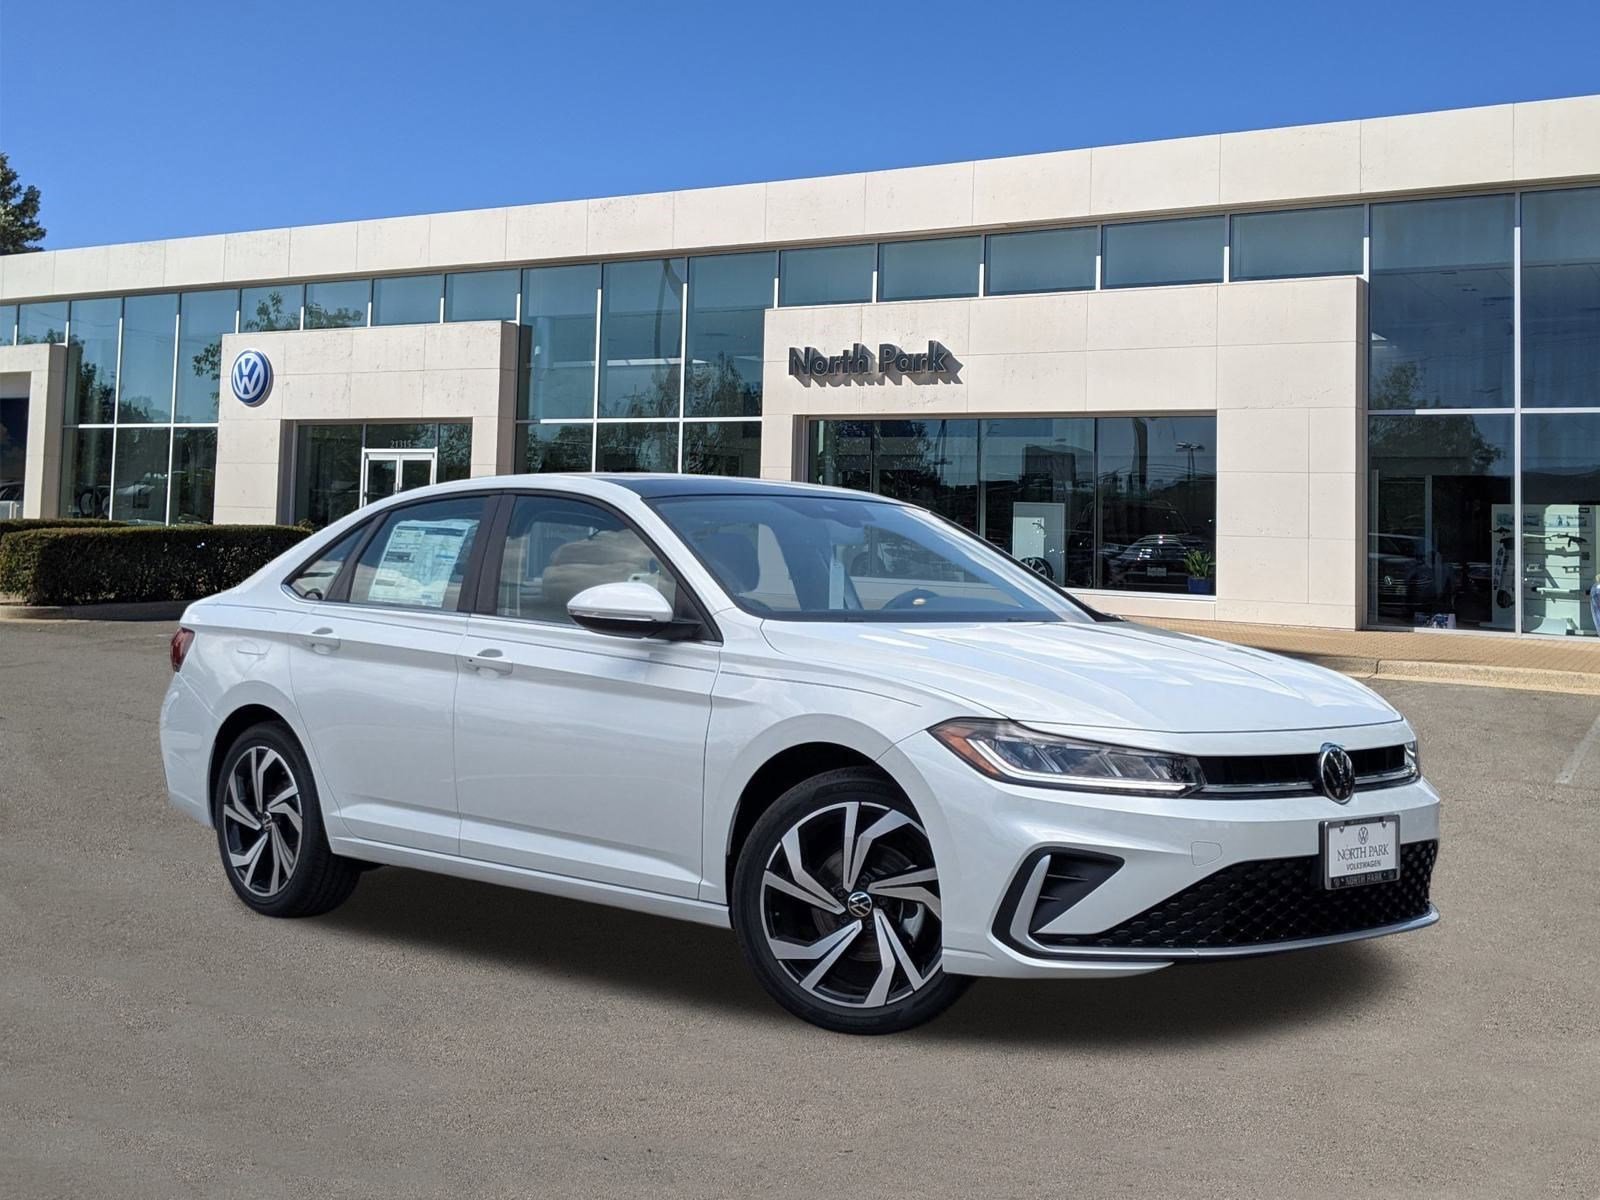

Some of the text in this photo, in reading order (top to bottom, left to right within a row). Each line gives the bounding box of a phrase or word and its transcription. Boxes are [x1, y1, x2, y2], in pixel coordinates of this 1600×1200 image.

[788, 340, 948, 376] North Park
[232, 349, 269, 403] VW
[390, 439, 412, 449] 21315
[1336, 843, 1389, 861] NORTH PARK
[1346, 860, 1382, 871] VOLKSWAGEN
